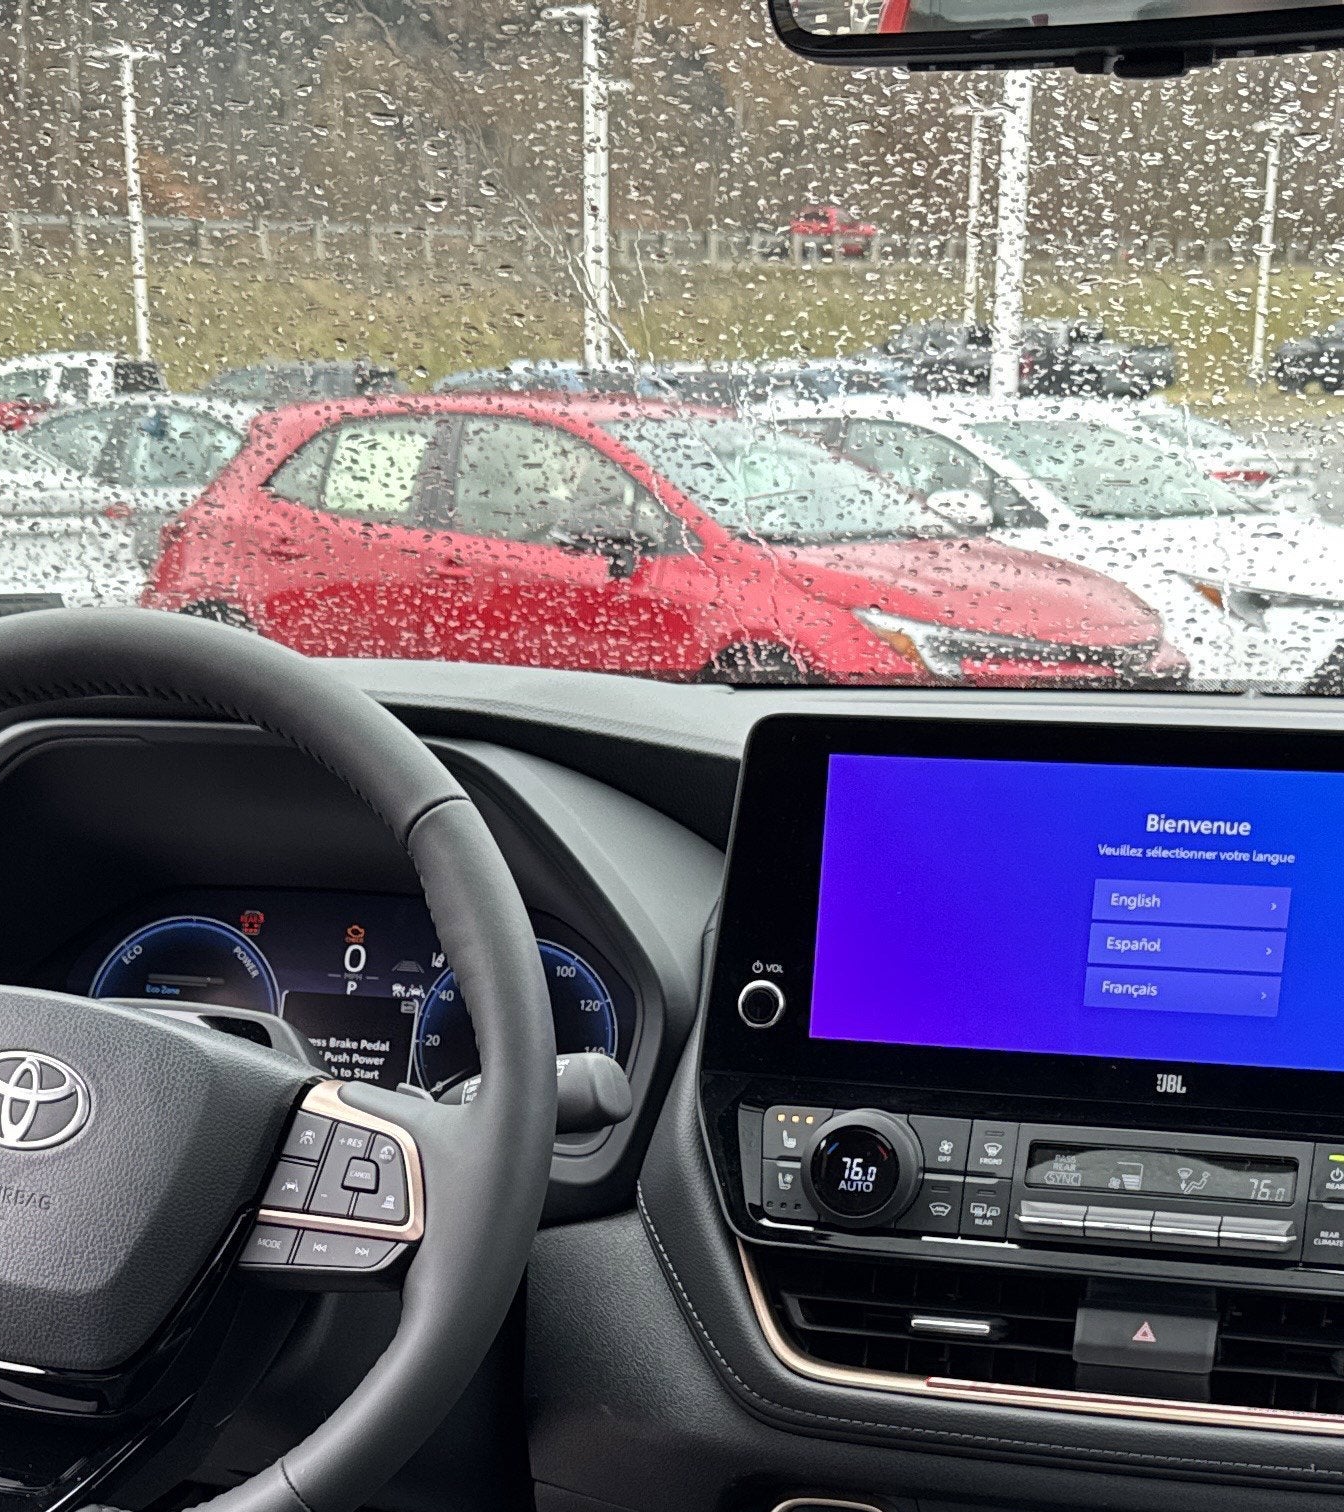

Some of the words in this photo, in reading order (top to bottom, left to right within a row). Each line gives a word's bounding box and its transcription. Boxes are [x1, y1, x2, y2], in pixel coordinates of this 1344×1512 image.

[1146, 814, 1252, 836] Bienvenue
[1098, 844, 1143, 858] Veuillez
[1145, 846, 1218, 861] sélectionner
[1219, 850, 1250, 862] votre
[1253, 850, 1296, 865] langue
[1109, 892, 1161, 910] English
[1105, 936, 1162, 953] Español
[121, 944, 143, 965] ECO
[344, 944, 366, 973] 0
[232, 945, 260, 979] POWER
[766, 963, 784, 974] VOL
[555, 965, 577, 978] 100
[346, 980, 358, 996] P
[1101, 980, 1159, 998] Français
[439, 989, 455, 1002] 40
[580, 999, 601, 1012] 120
[329, 1037, 358, 1049] Brake
[360, 1039, 390, 1052] Pedal
[425, 1034, 441, 1047] 20
[324, 1051, 350, 1063] Push
[352, 1053, 385, 1066] Power
[340, 1067, 352, 1078] to
[354, 1068, 380, 1080] Start
[1156, 1073, 1187, 1094] JBL
[937, 1155, 951, 1163] OFF
[979, 1157, 1003, 1166] FRONT
[348, 1169, 372, 1181] CANCEL
[842, 1157, 878, 1182] 76.0
[838, 1180, 874, 1193] AUTO
[1249, 1177, 1287, 1202] 76.0
[974, 1218, 993, 1227] REAR
[1320, 1230, 1340, 1240] REAR
[257, 1237, 283, 1251] MODE
[1313, 1238, 1344, 1248] CLIMATE
